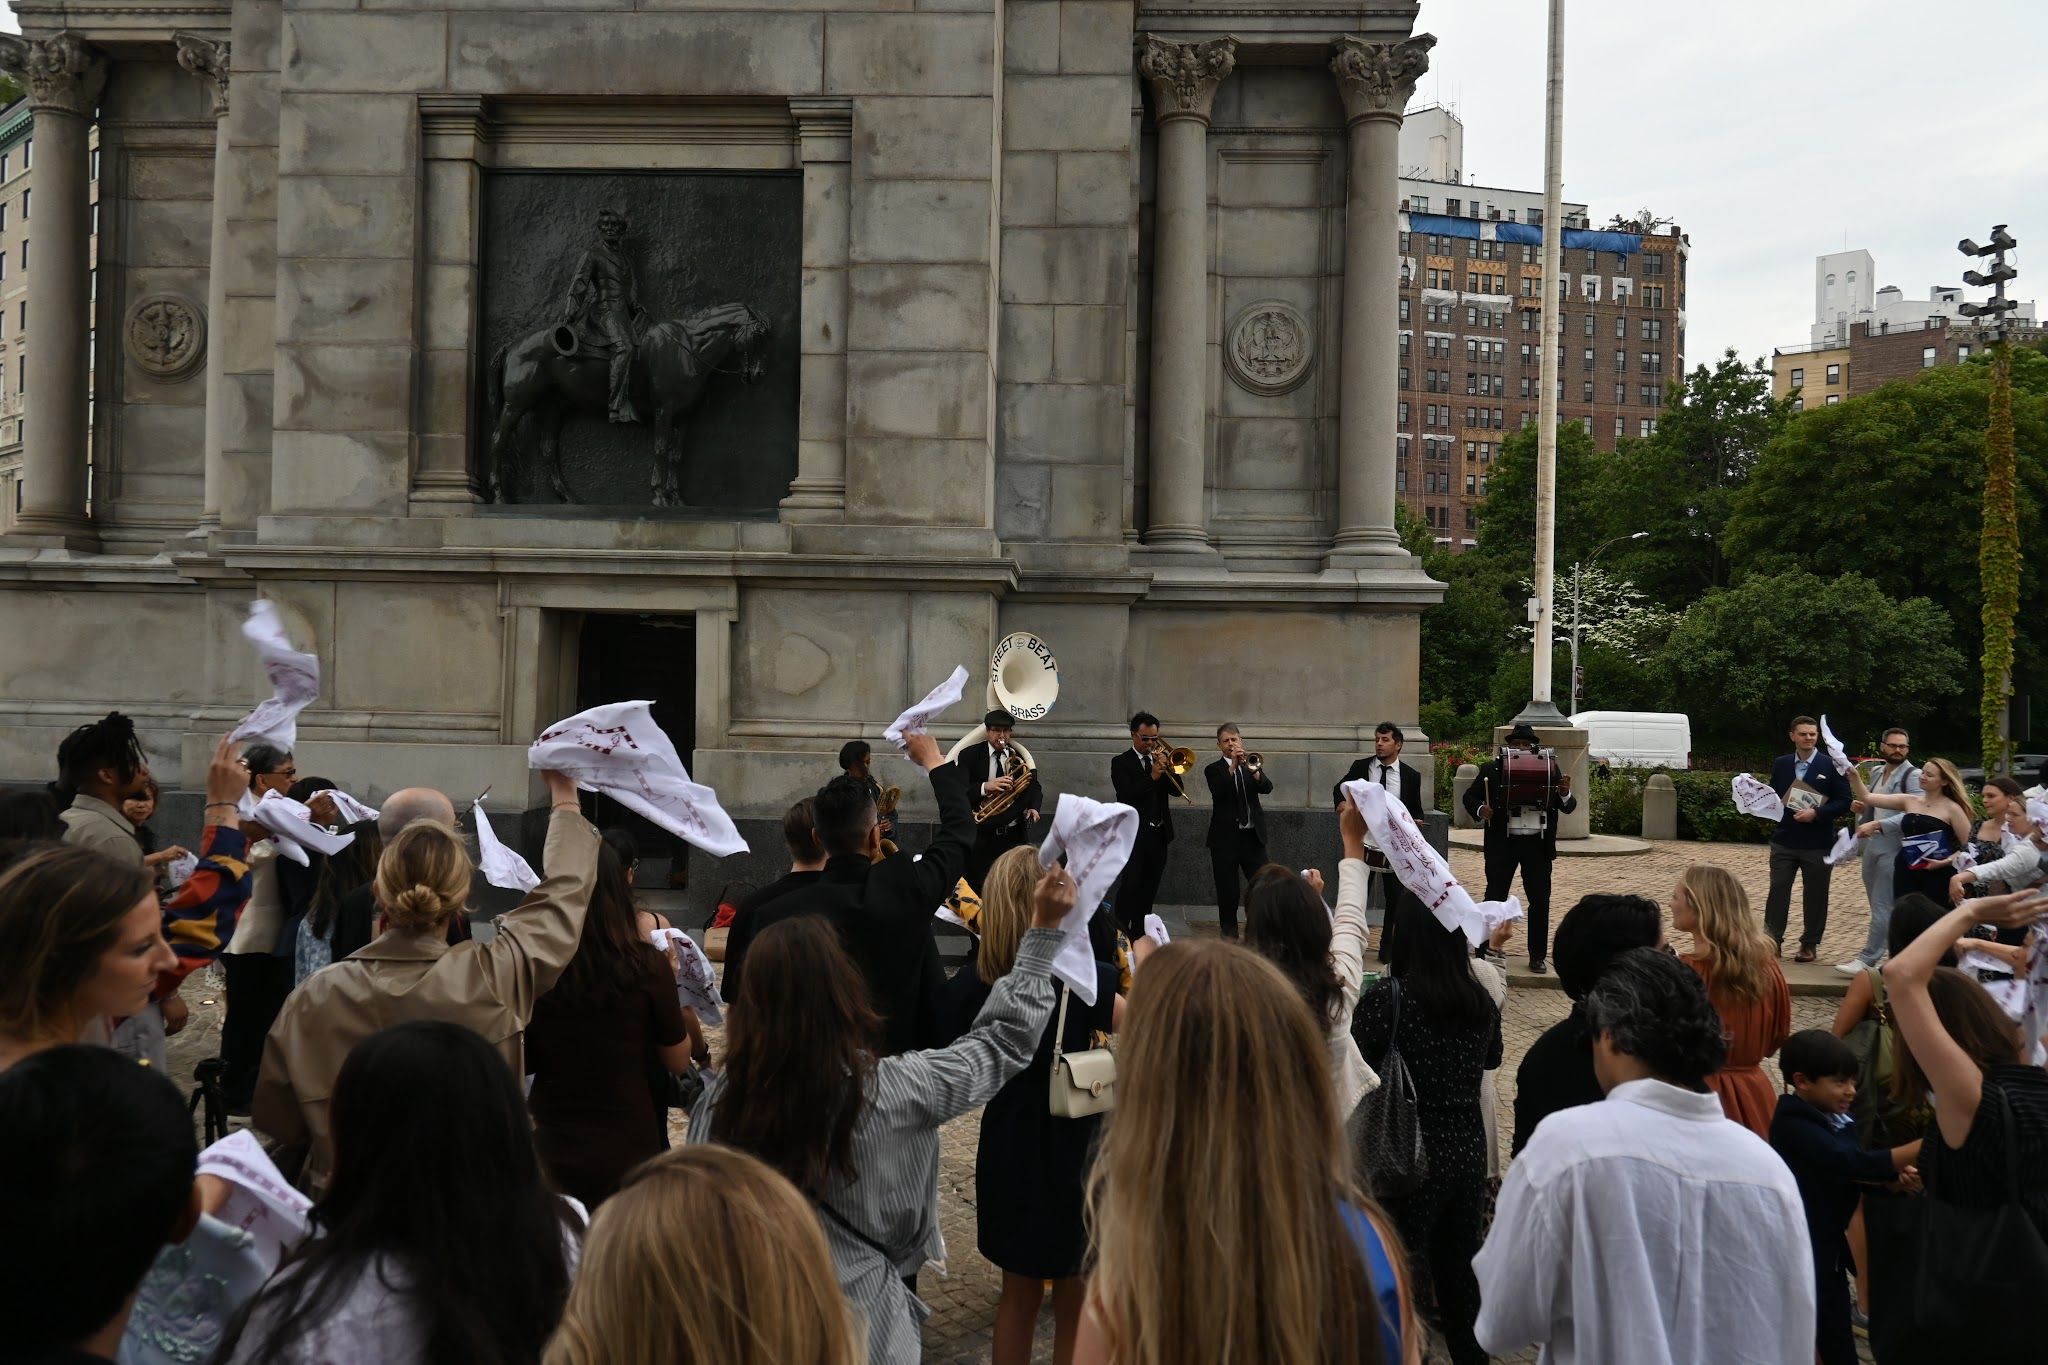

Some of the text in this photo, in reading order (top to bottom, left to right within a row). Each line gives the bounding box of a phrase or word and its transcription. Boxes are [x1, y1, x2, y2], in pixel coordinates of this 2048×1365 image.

[992, 637, 1056, 683] STREET BEAT
[1010, 703, 1046, 719] BRASS
